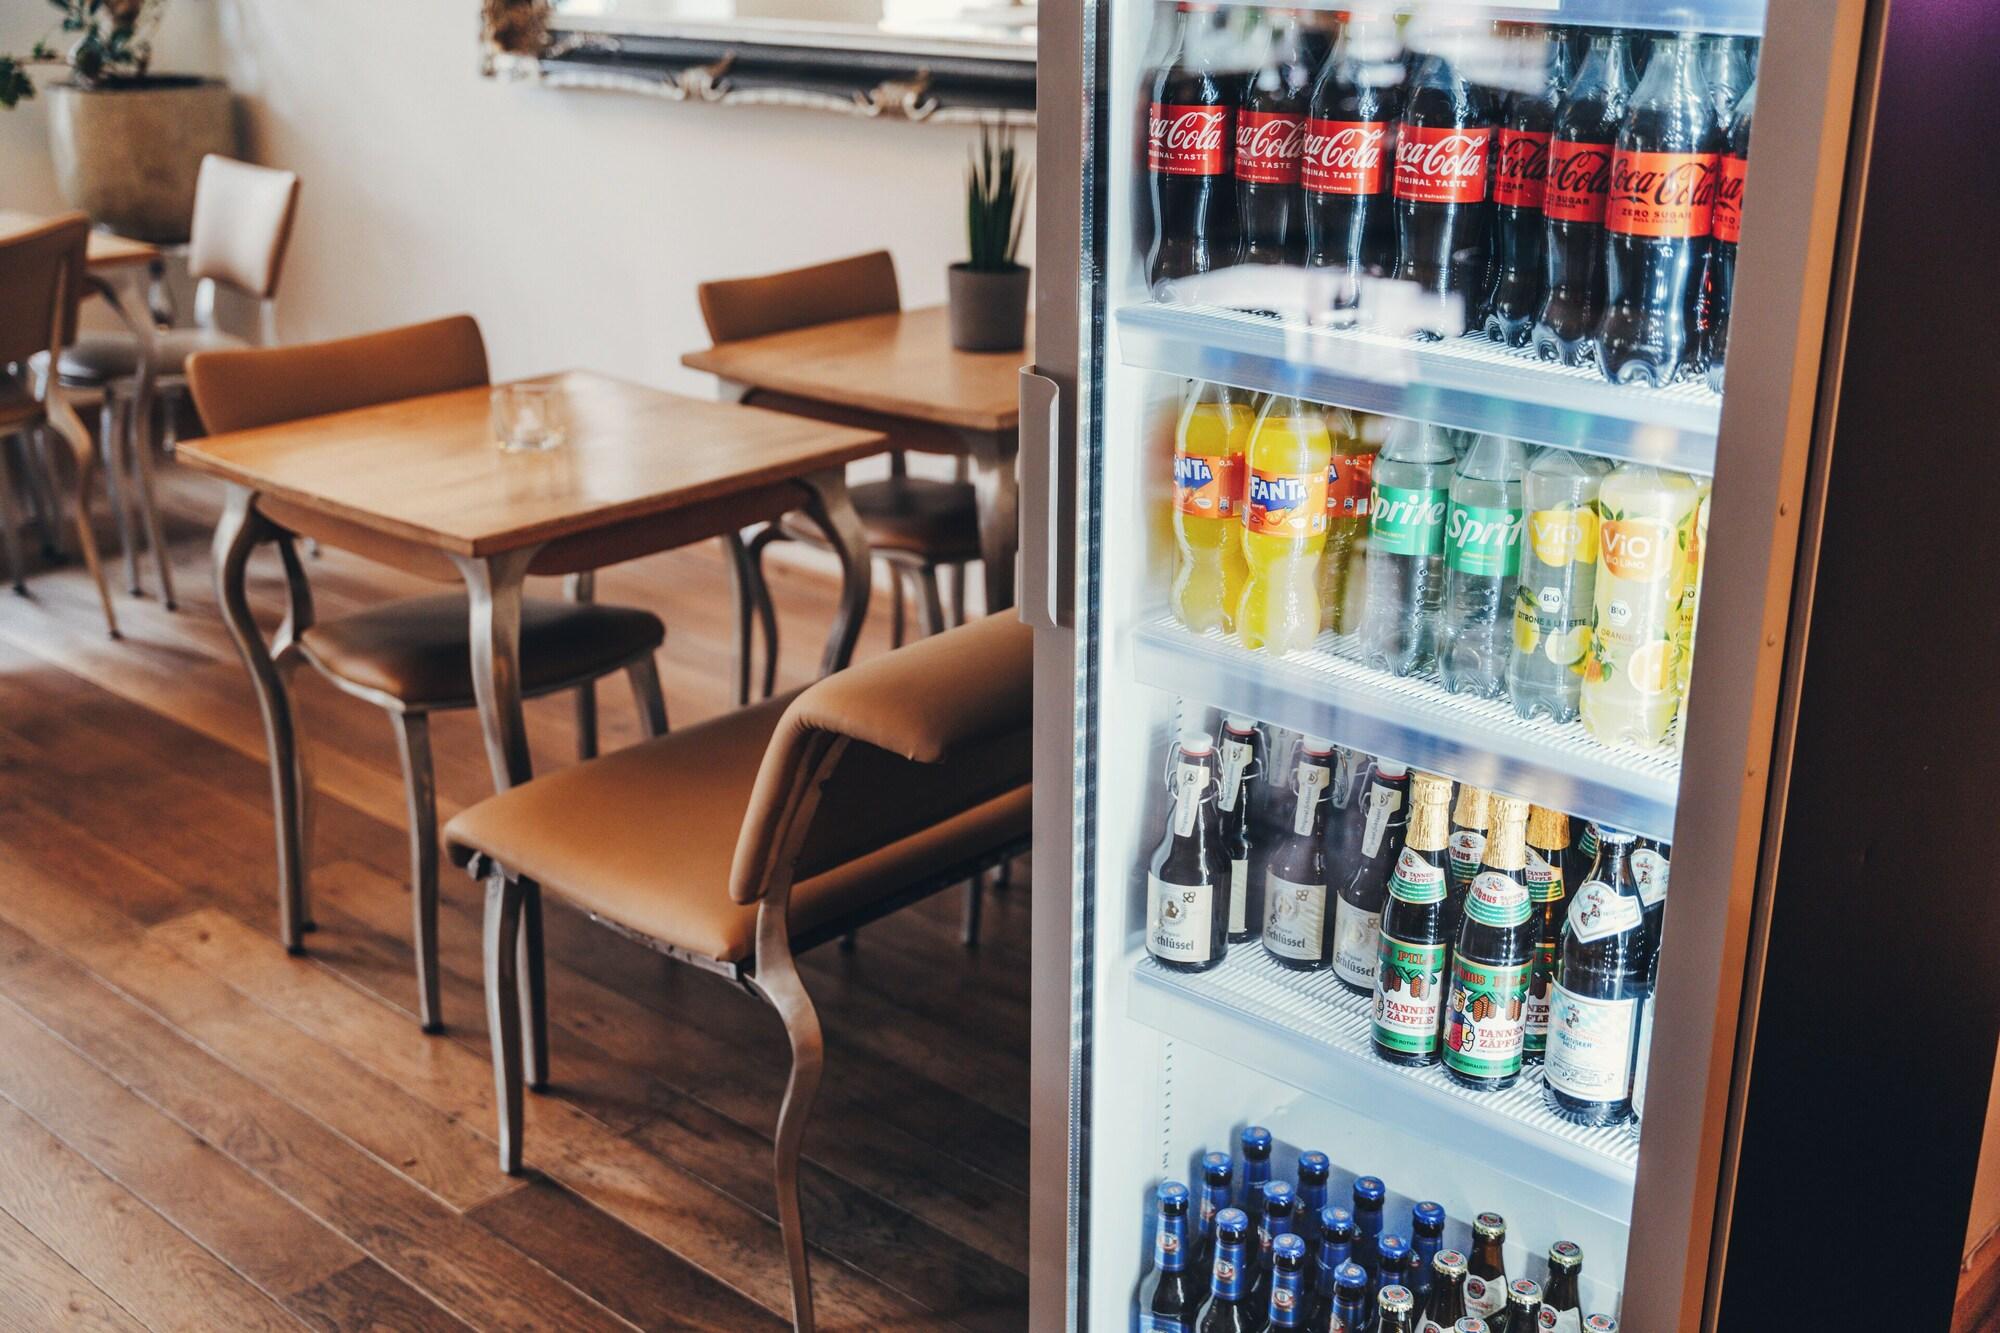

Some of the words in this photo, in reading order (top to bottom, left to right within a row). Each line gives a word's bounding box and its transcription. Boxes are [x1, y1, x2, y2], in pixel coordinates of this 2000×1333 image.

[1178, 153, 1209, 161] TASTE
[1261, 161, 1292, 169] TASTE
[1333, 171, 1365, 180] TASTE
[1435, 180, 1468, 188] TASTE
[1556, 194, 1590, 205] SUGAR
[1621, 208, 1649, 218] ZERO
[1654, 210, 1692, 219] SUGAR
[1251, 476, 1307, 501] FANTA
[1369, 486, 1446, 527] Sprite
[1449, 509, 1523, 548] Sprit
[1517, 611, 1545, 626] ZITRONE
[1152, 935, 1194, 951] chlüssel
[1335, 951, 1376, 978] Schlüssel
[1386, 999, 1436, 1015] TANNEN
[1478, 1023, 1525, 1038] TANNEN
